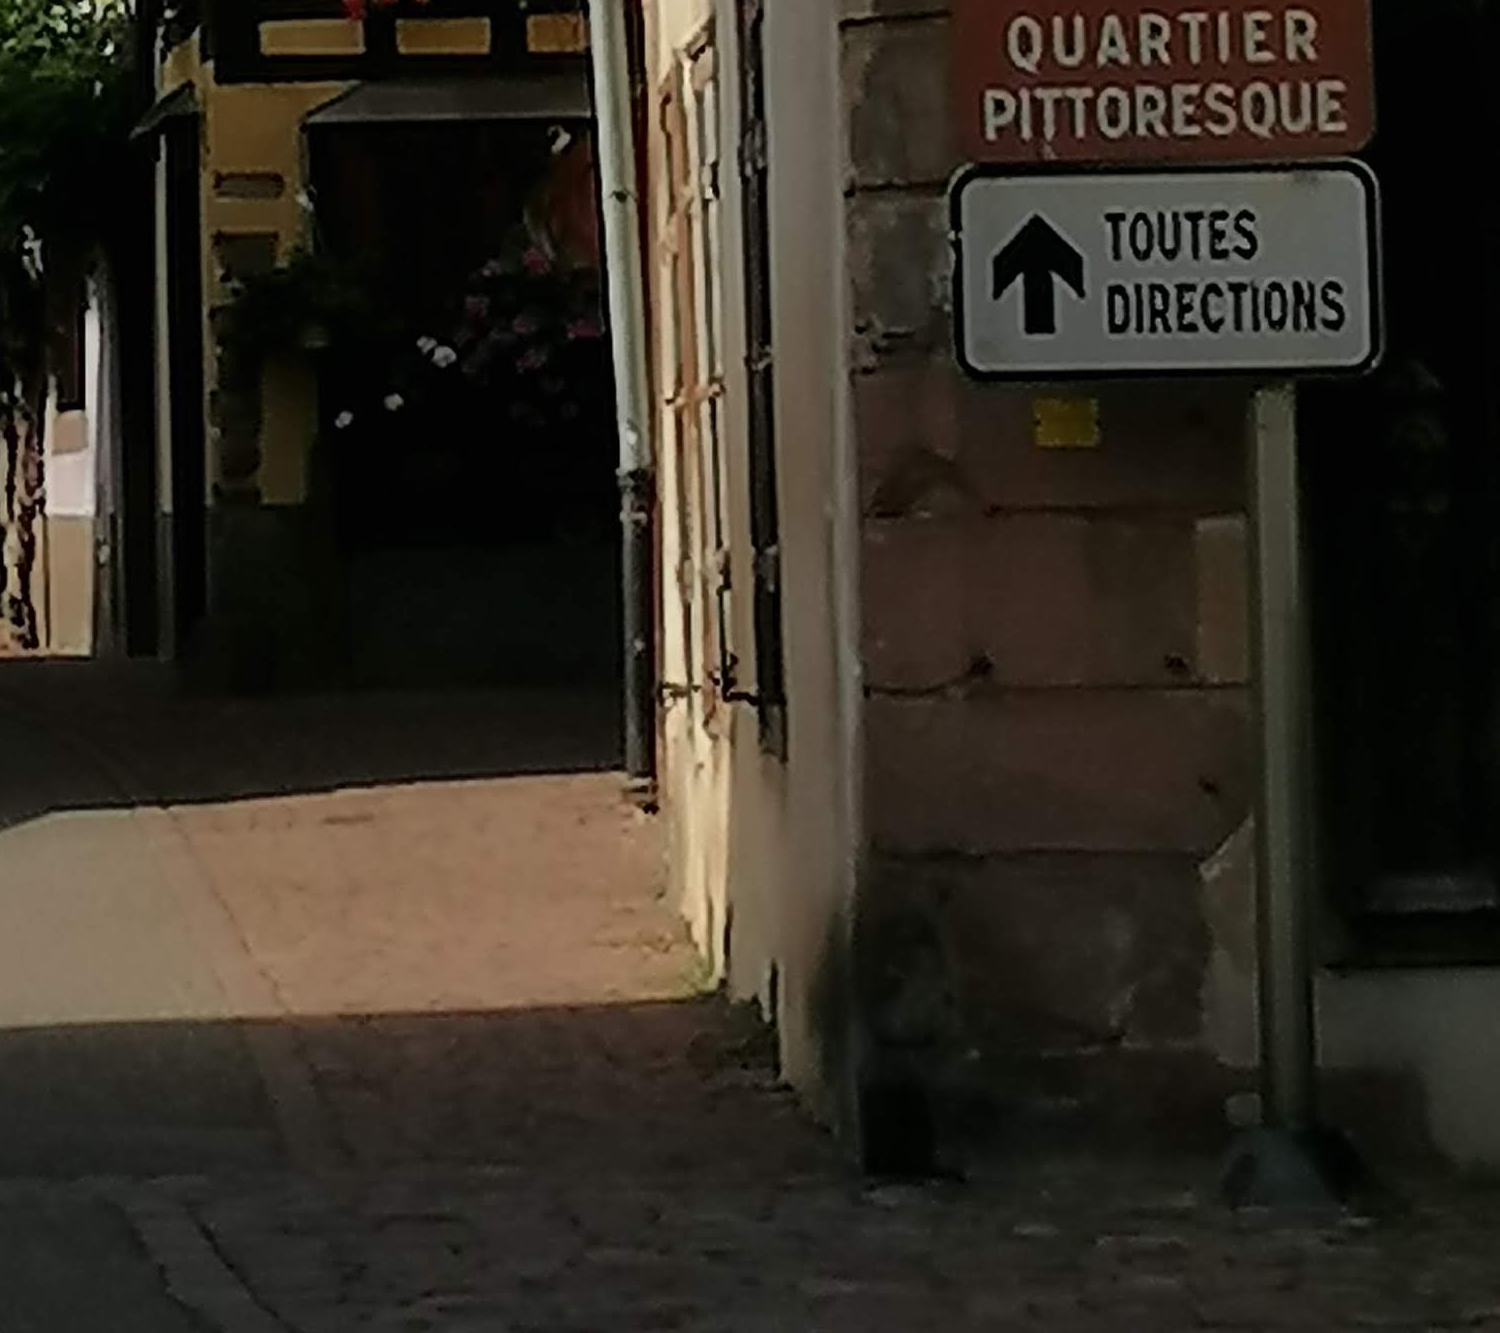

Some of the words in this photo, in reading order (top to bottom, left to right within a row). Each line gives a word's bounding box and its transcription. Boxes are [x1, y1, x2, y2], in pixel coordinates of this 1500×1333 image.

[1006, 9, 1319, 74] QUARTIER
[982, 79, 1349, 141] PITTORESQUE
[1104, 209, 1259, 262] TOUTES
[1106, 279, 1347, 334] DIRECTIONS
